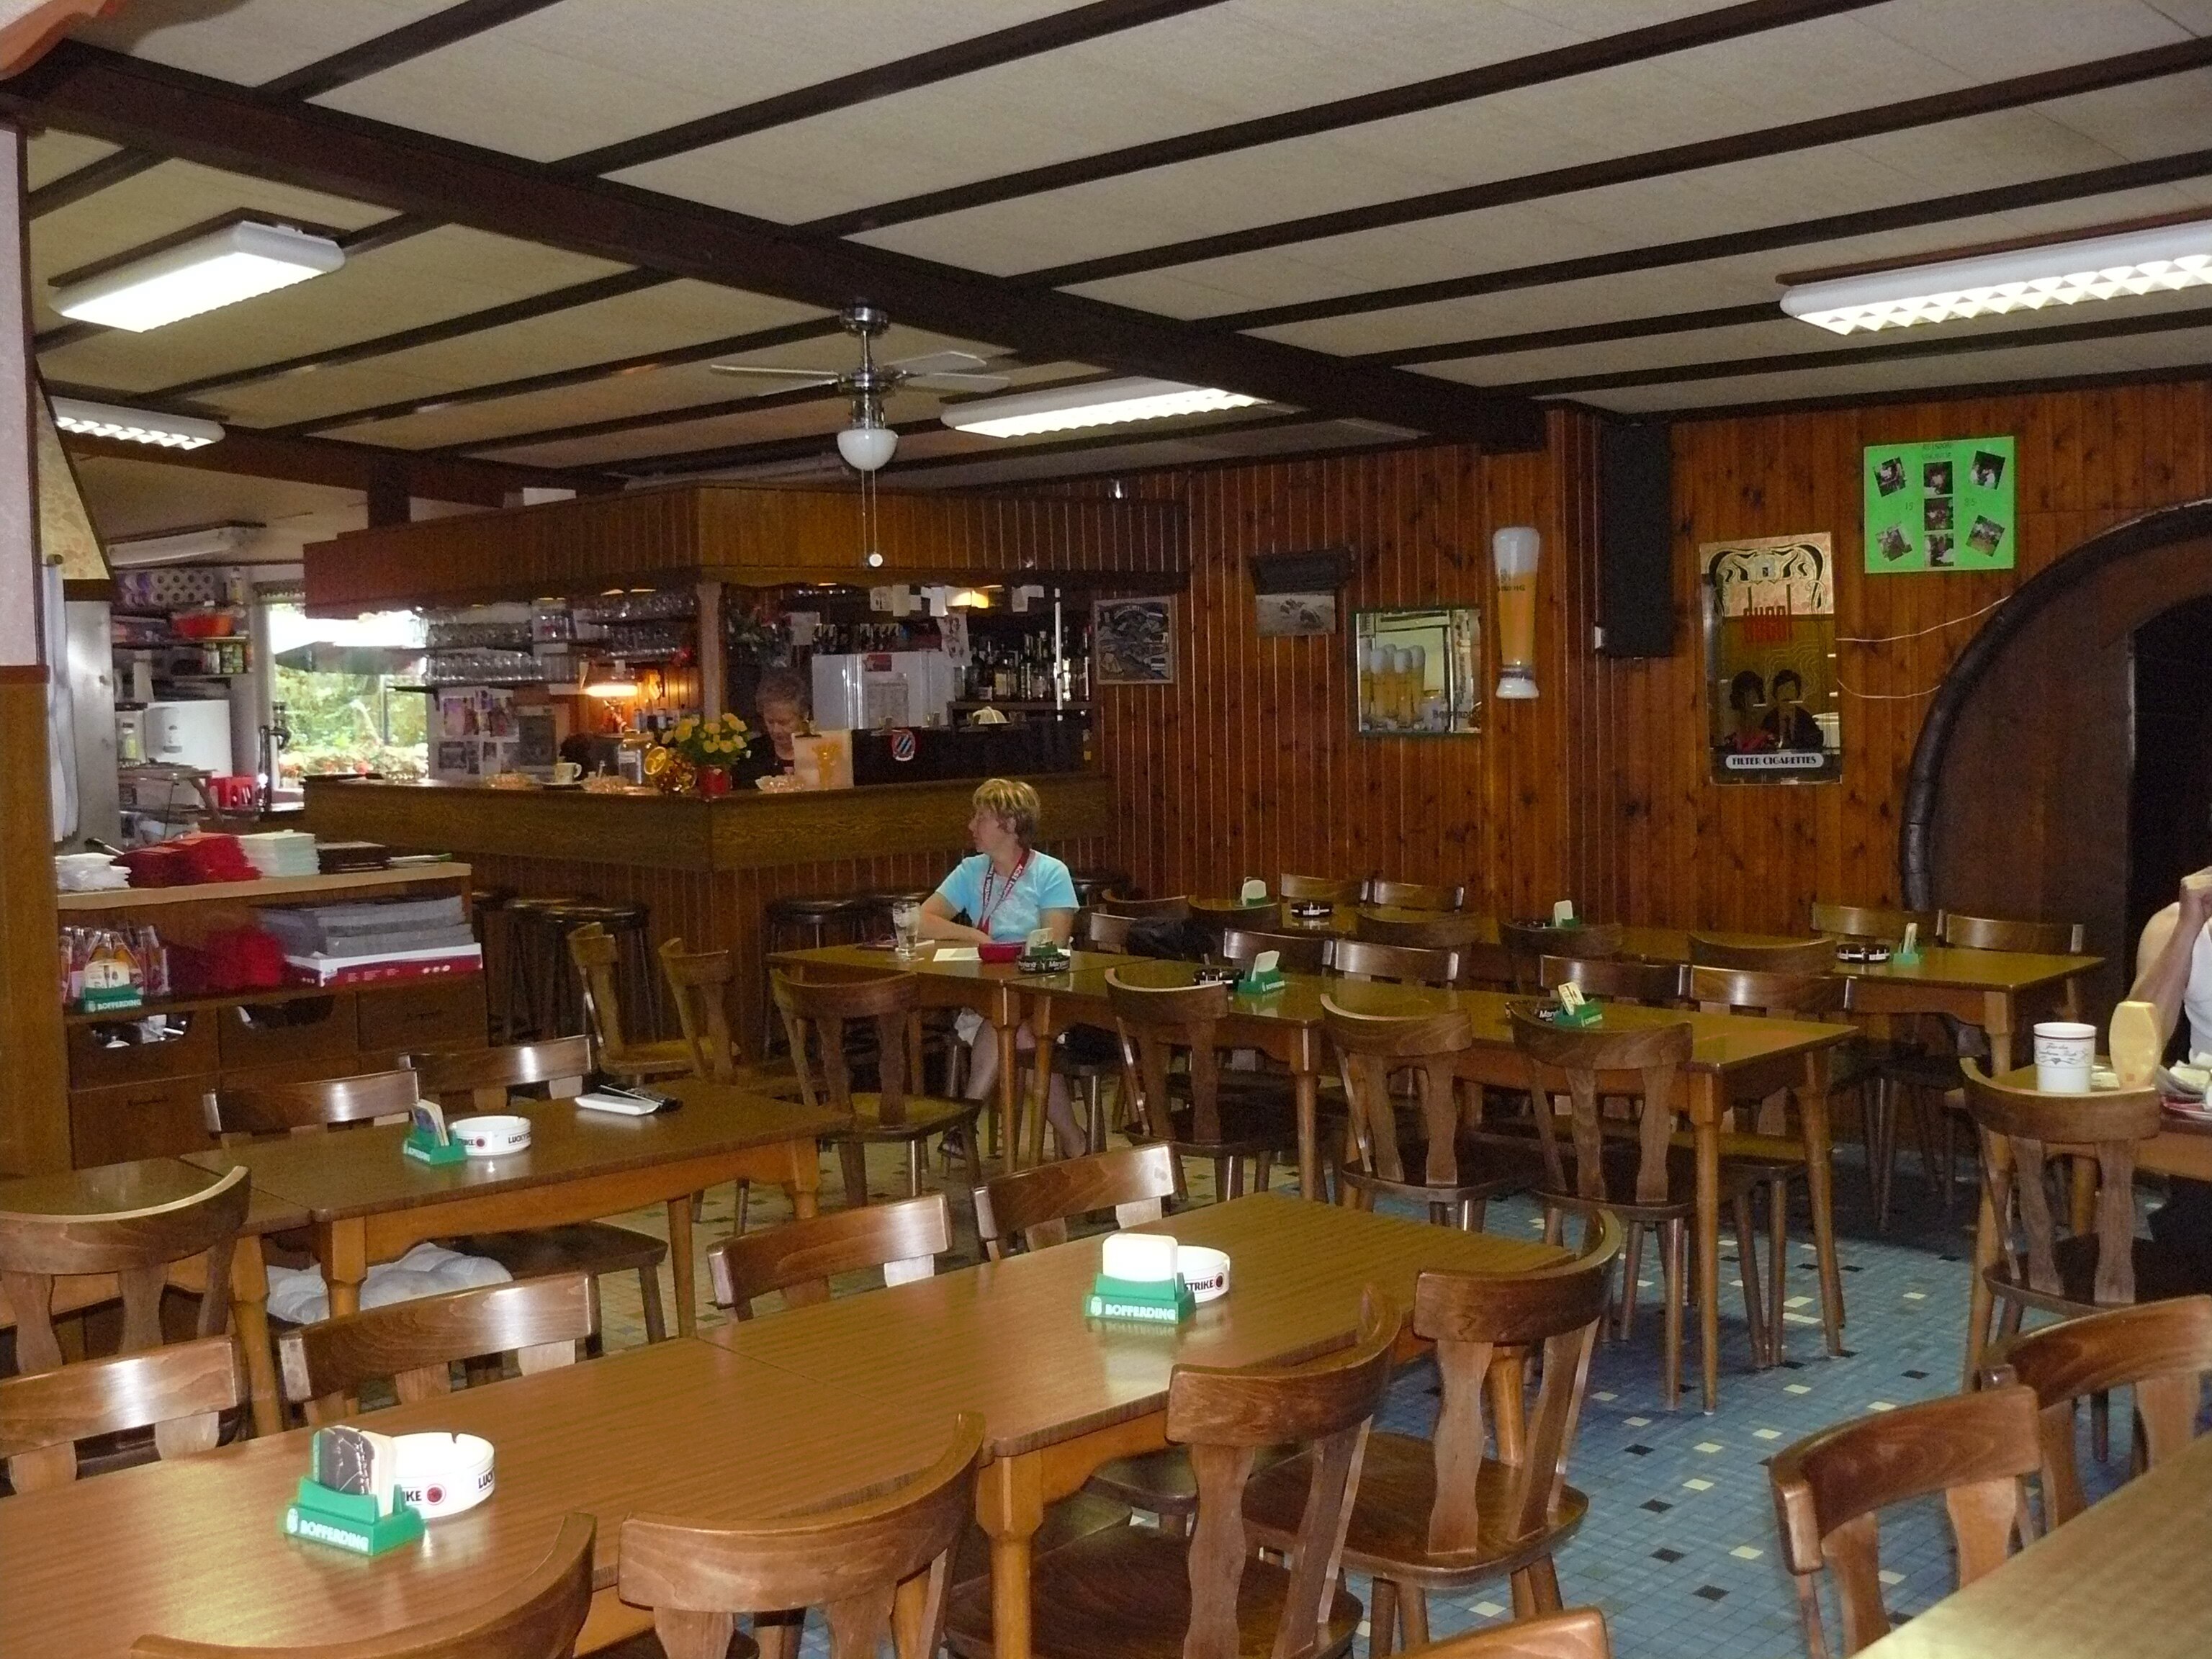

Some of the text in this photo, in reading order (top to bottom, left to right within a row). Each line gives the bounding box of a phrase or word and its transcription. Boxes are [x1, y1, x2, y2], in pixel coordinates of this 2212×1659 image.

[1732, 755, 1817, 765] FILTER CIGARETTES
[1105, 1303, 1176, 1321] BOFFERDING
[300, 1519, 369, 1552] BOFFERDING
